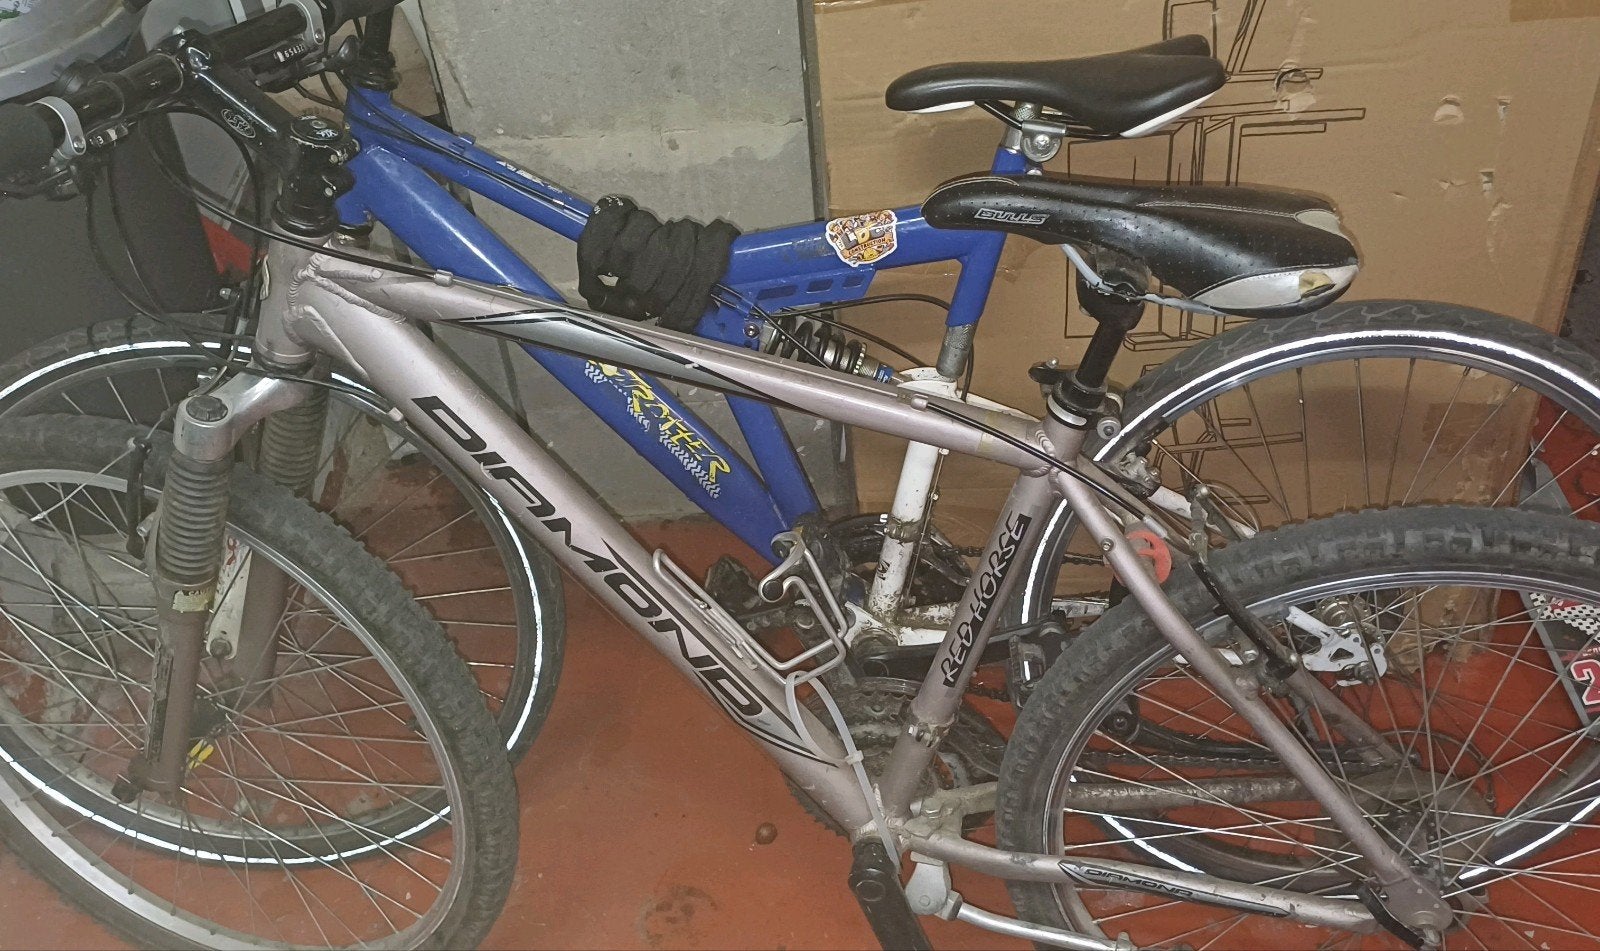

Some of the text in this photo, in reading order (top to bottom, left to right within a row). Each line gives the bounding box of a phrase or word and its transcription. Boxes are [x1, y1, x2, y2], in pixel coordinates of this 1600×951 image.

[974, 208, 1050, 225] BULLS
[848, 237, 886, 255] CONSTRUCTION
[411, 395, 764, 717] DIAMOND
[940, 510, 1028, 684] RED HORSE
[1084, 867, 1194, 898] DIAMOND
